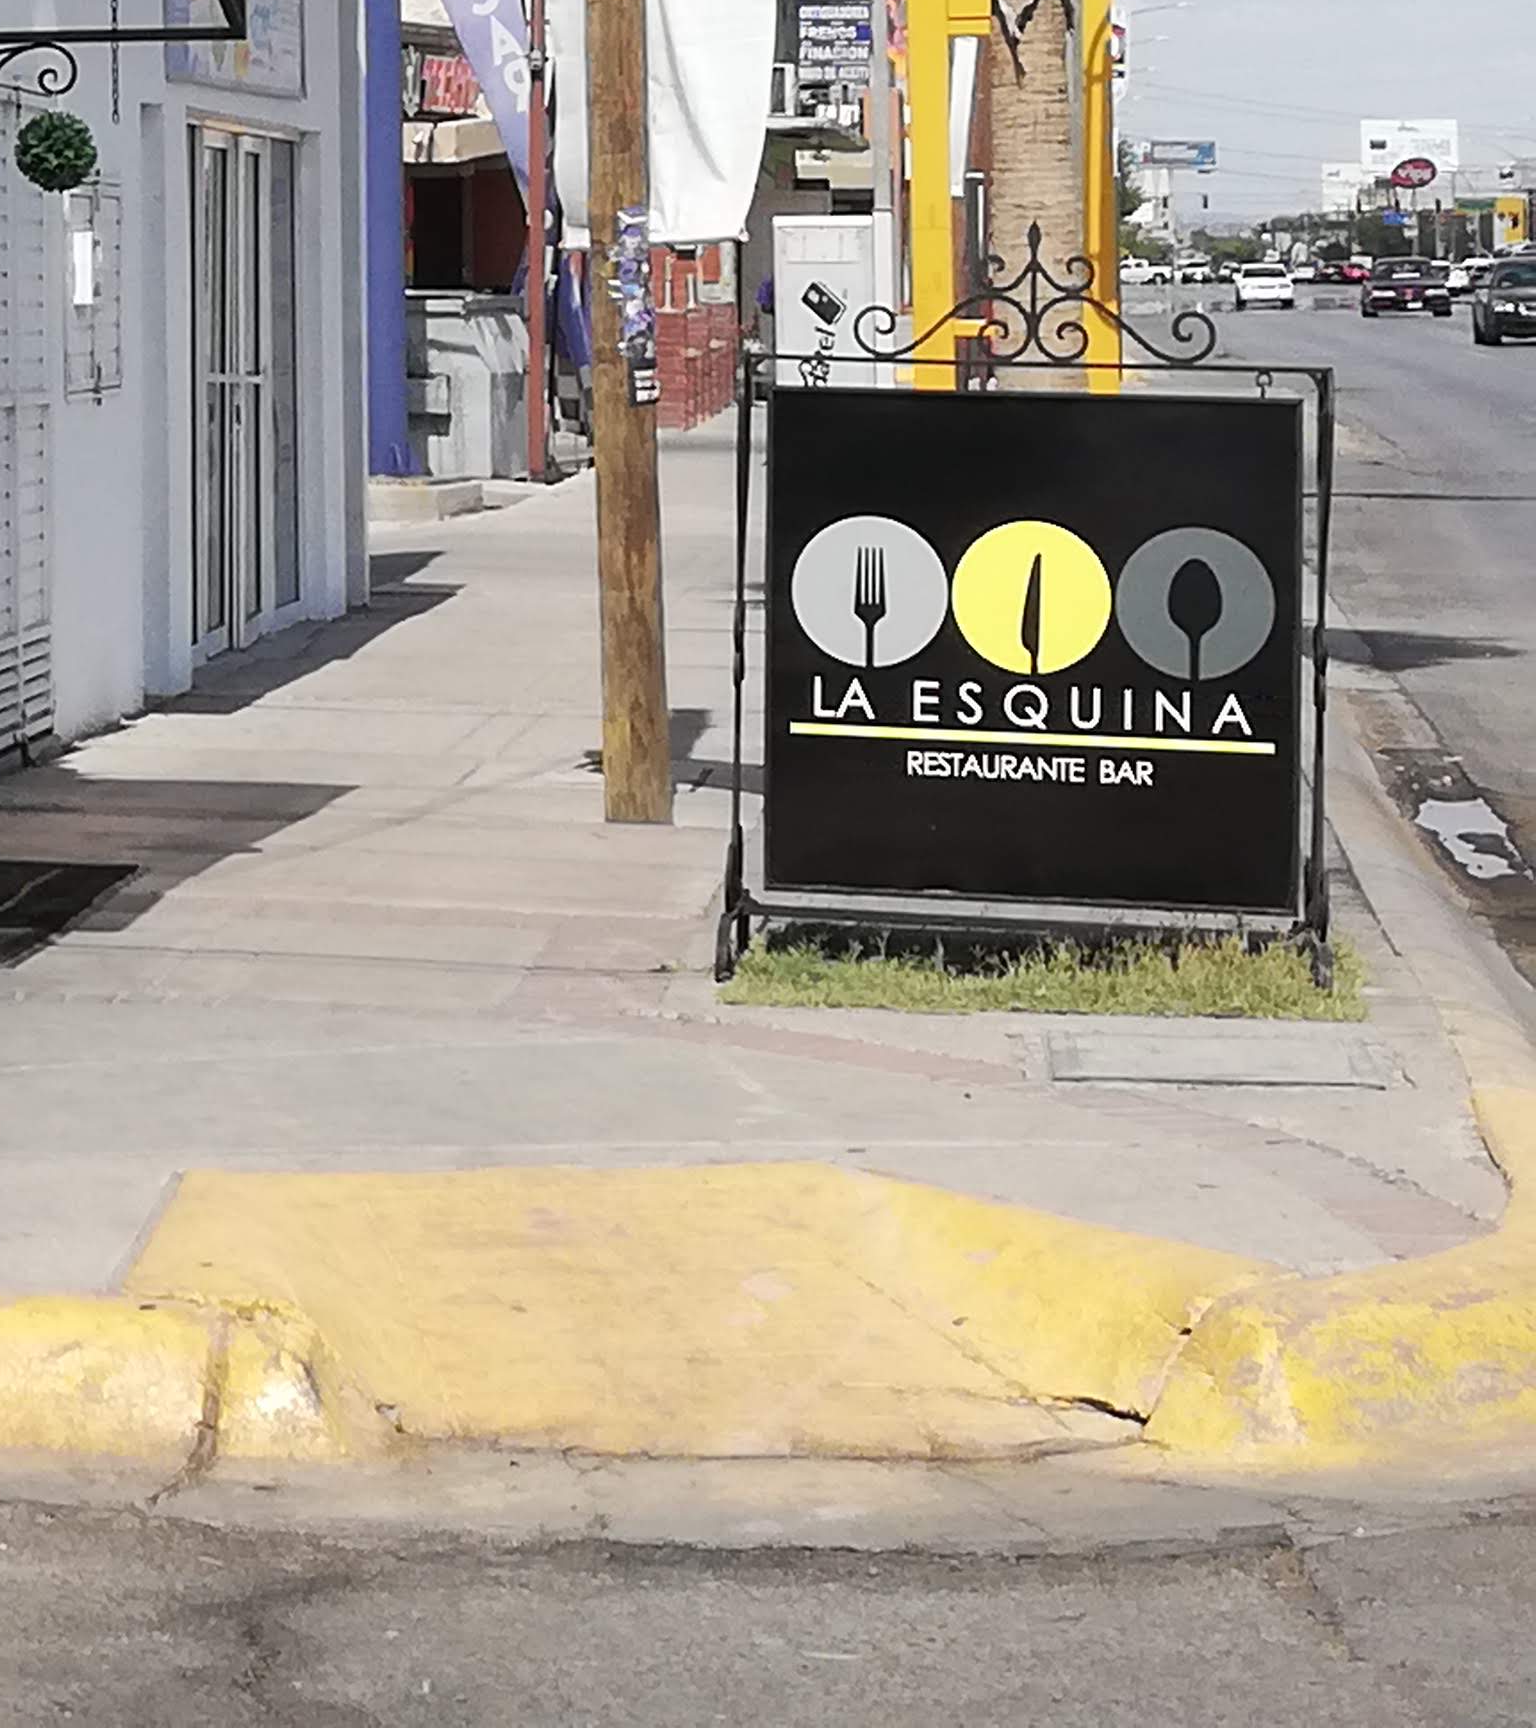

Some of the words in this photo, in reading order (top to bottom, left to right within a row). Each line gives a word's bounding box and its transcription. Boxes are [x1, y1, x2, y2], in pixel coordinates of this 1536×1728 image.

[812, 676, 875, 720] LA
[913, 680, 1253, 736] ESQUINA
[907, 749, 1086, 783] RESTAURANTE
[1099, 758, 1153, 786] BAR
